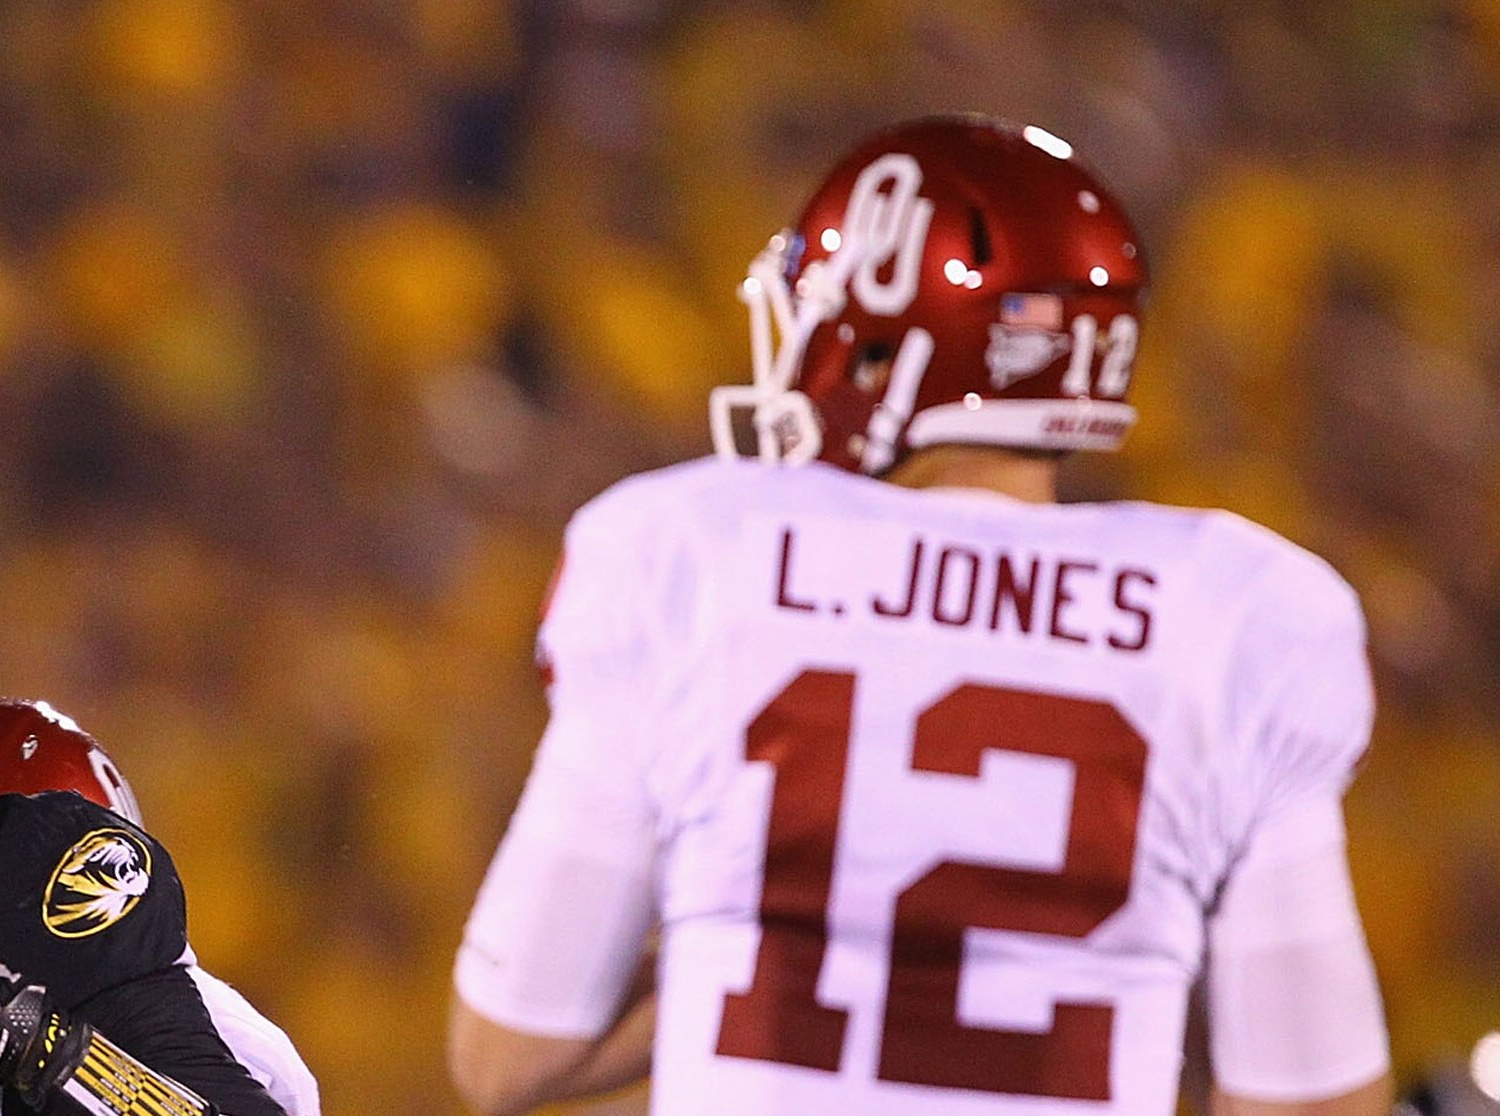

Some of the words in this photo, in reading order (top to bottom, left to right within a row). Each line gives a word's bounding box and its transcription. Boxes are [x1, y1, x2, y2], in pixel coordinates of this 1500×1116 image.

[1061, 313, 1139, 397] 12
[871, 538, 1158, 652] JONES
[713, 667, 1151, 1103] 12
